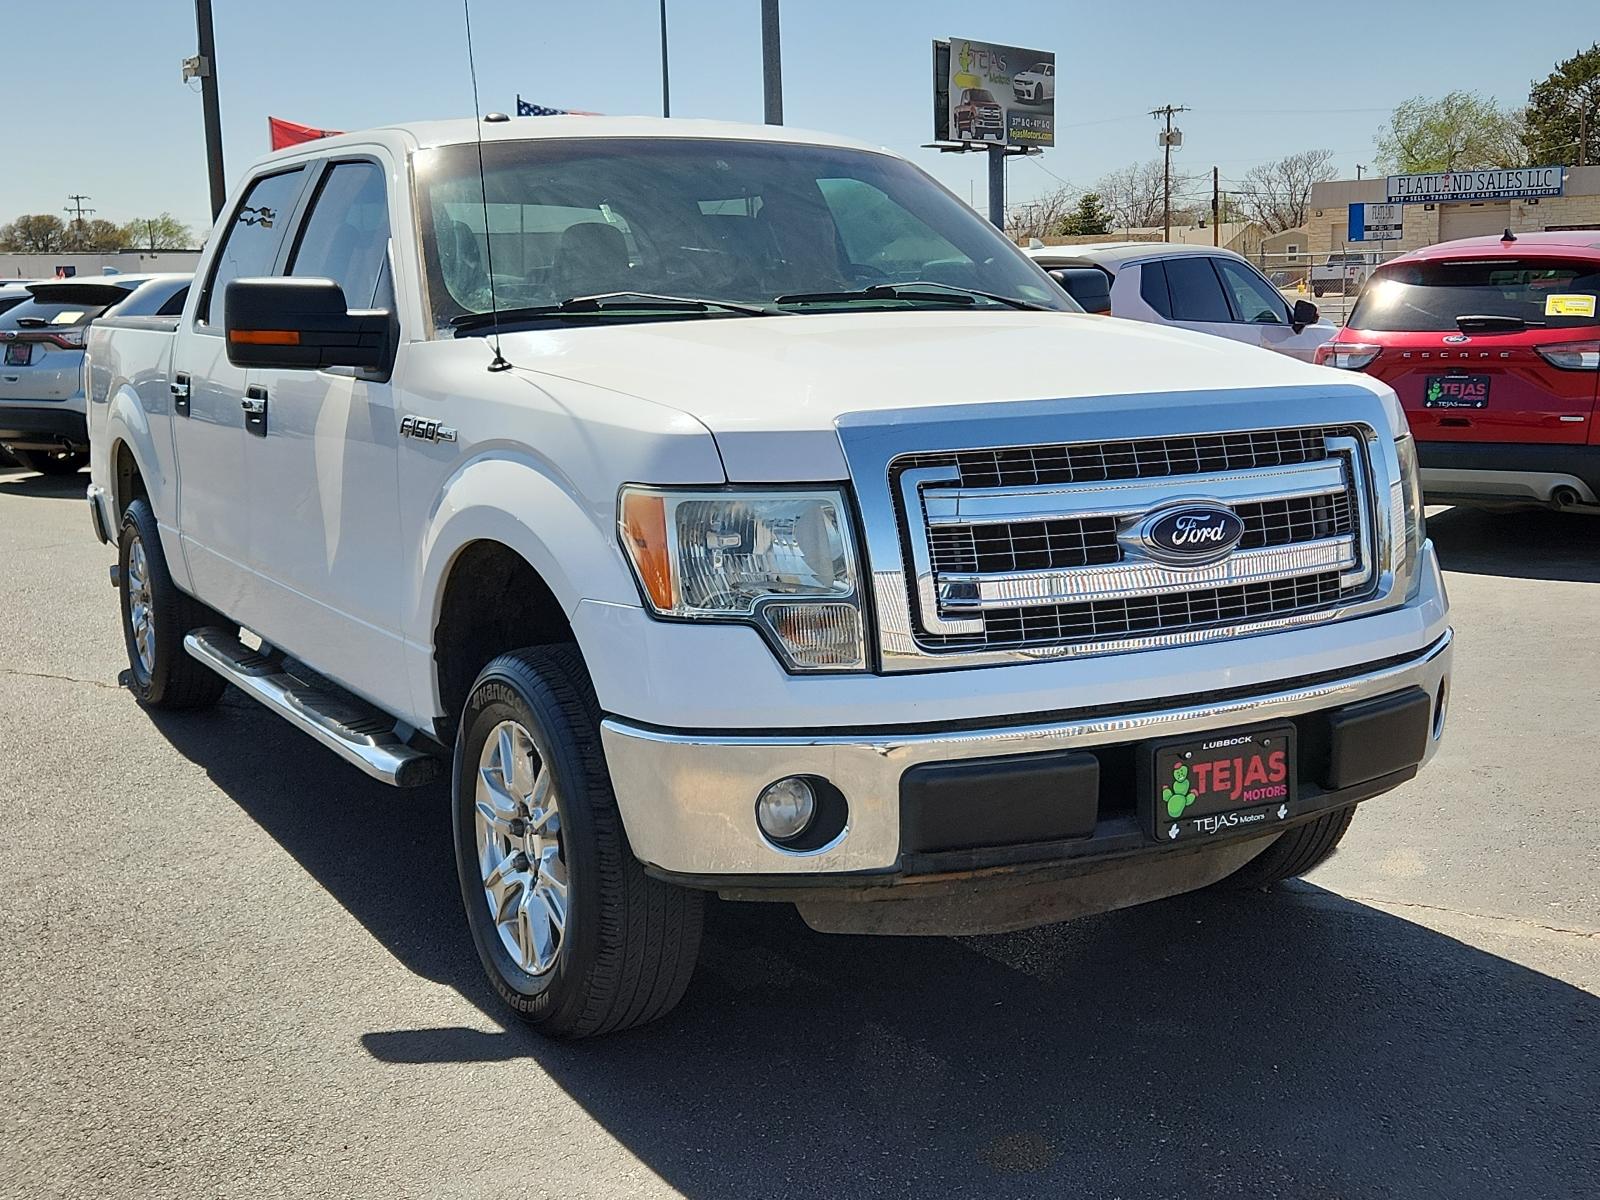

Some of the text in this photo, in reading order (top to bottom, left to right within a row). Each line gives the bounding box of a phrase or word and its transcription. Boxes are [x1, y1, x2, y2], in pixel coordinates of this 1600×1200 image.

[970, 49, 1007, 72] TEJAS
[1009, 127, 1053, 140] TejasMotors.com
[1397, 169, 1553, 195] FLATLAND SALES LLC
[1430, 193, 1452, 201] TRADE
[1519, 188, 1559, 196] FINANCING
[1441, 383, 1486, 398] TEJAS
[1171, 514, 1226, 545] Ford
[1202, 735, 1252, 750] LUBBOCK
[1192, 751, 1287, 800] TEJAS
[1243, 784, 1287, 801] MOTORS
[1193, 813, 1265, 834] TEJAS Motors
